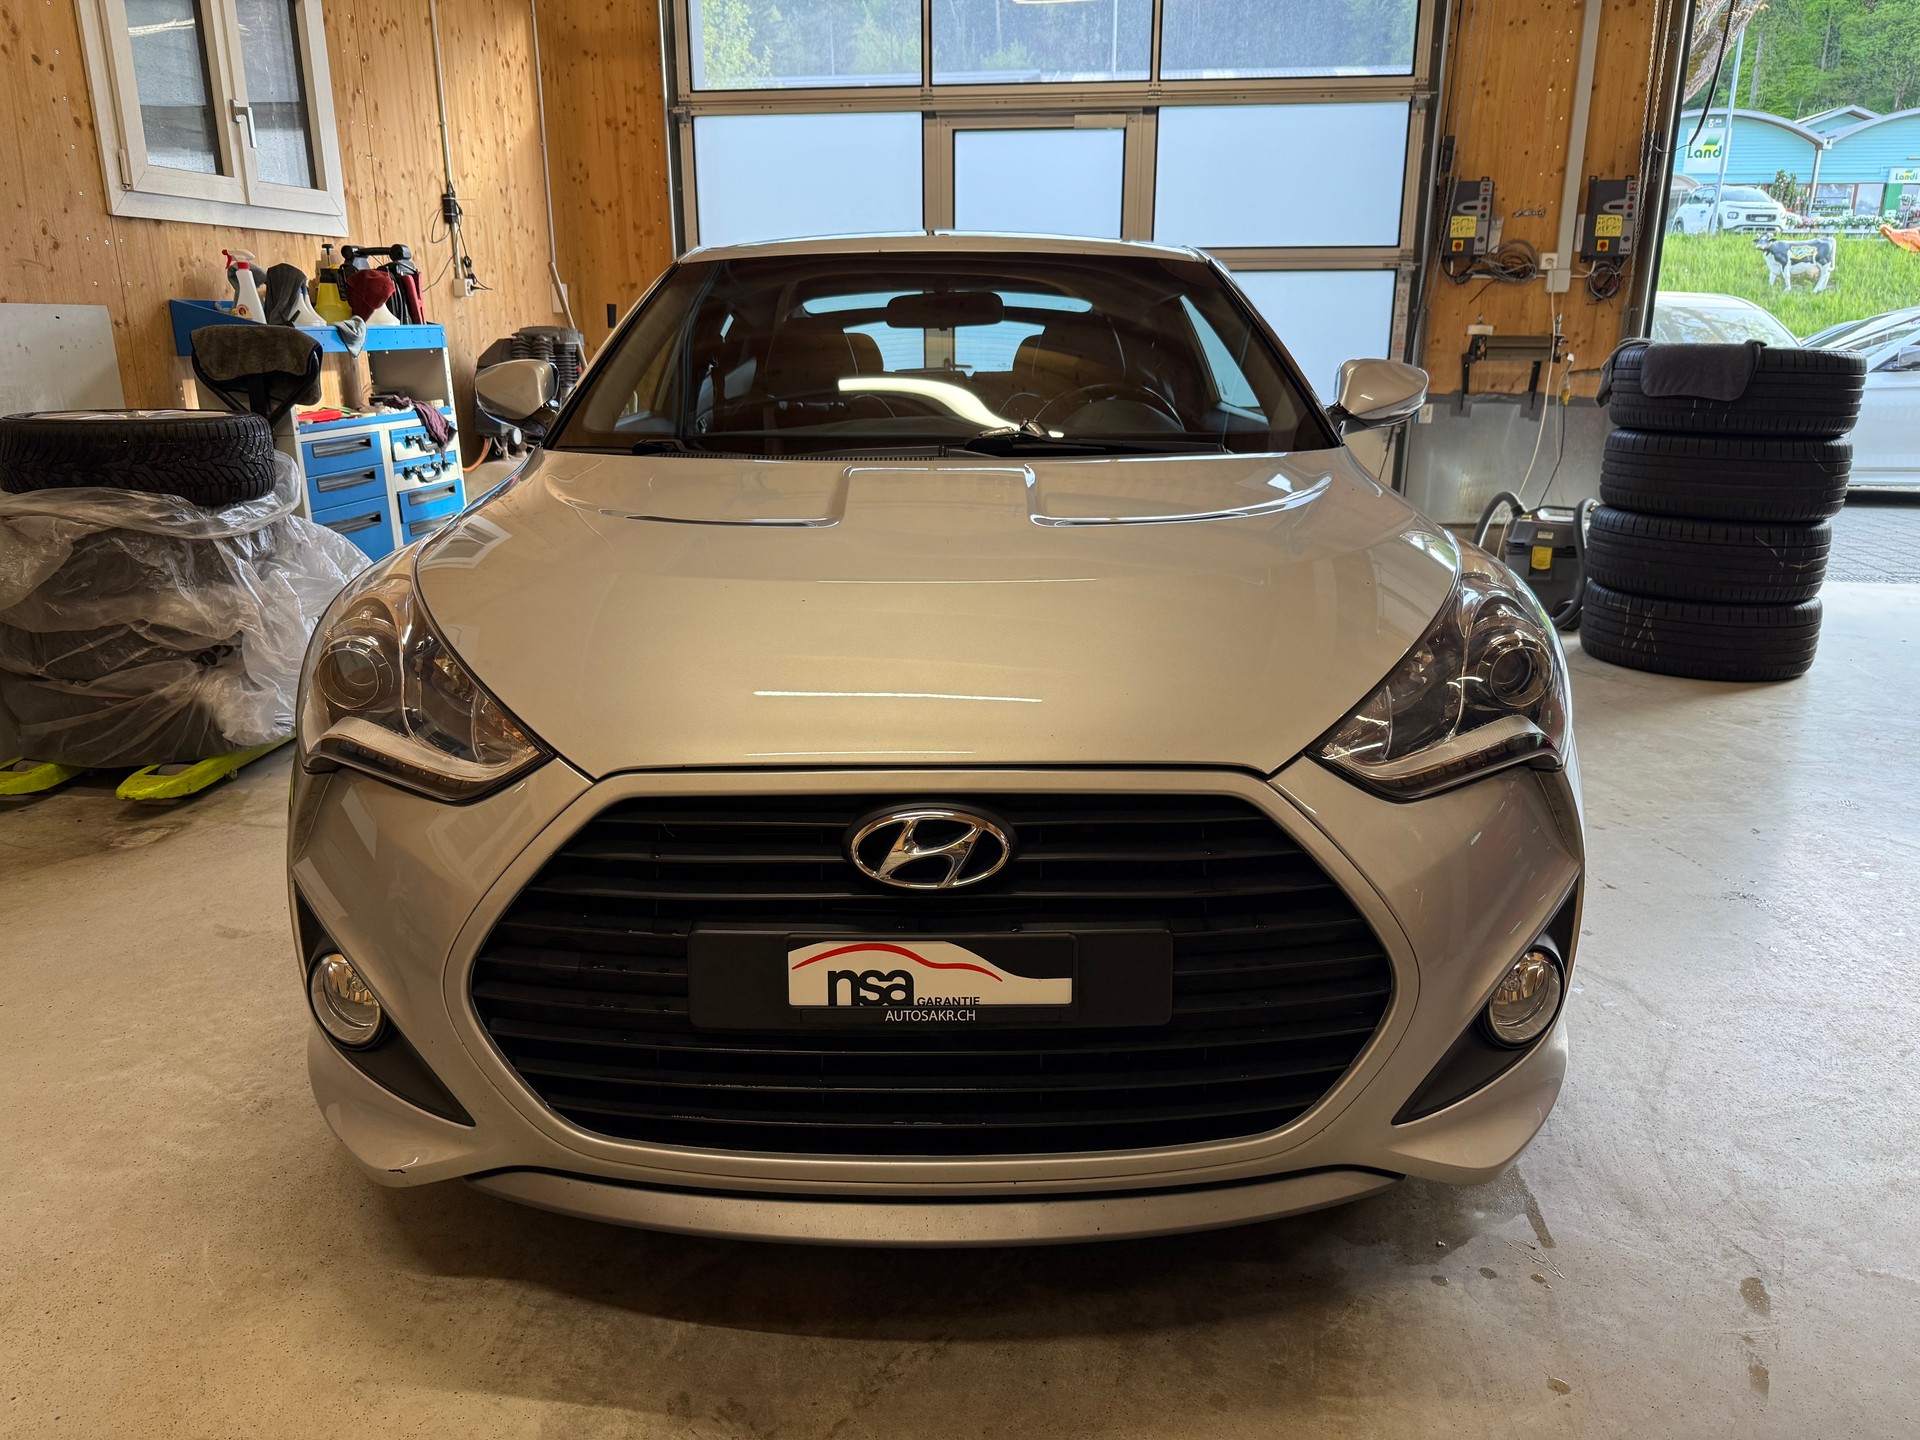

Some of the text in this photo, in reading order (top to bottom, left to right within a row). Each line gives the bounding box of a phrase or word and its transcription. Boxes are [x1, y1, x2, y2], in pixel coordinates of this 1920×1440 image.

[1687, 145, 1723, 159] Land
[1895, 172, 1919, 181] Landi
[827, 969, 981, 1006] nsa GARANTIE
[884, 1009, 977, 1022] AUTOSAKR.CH
